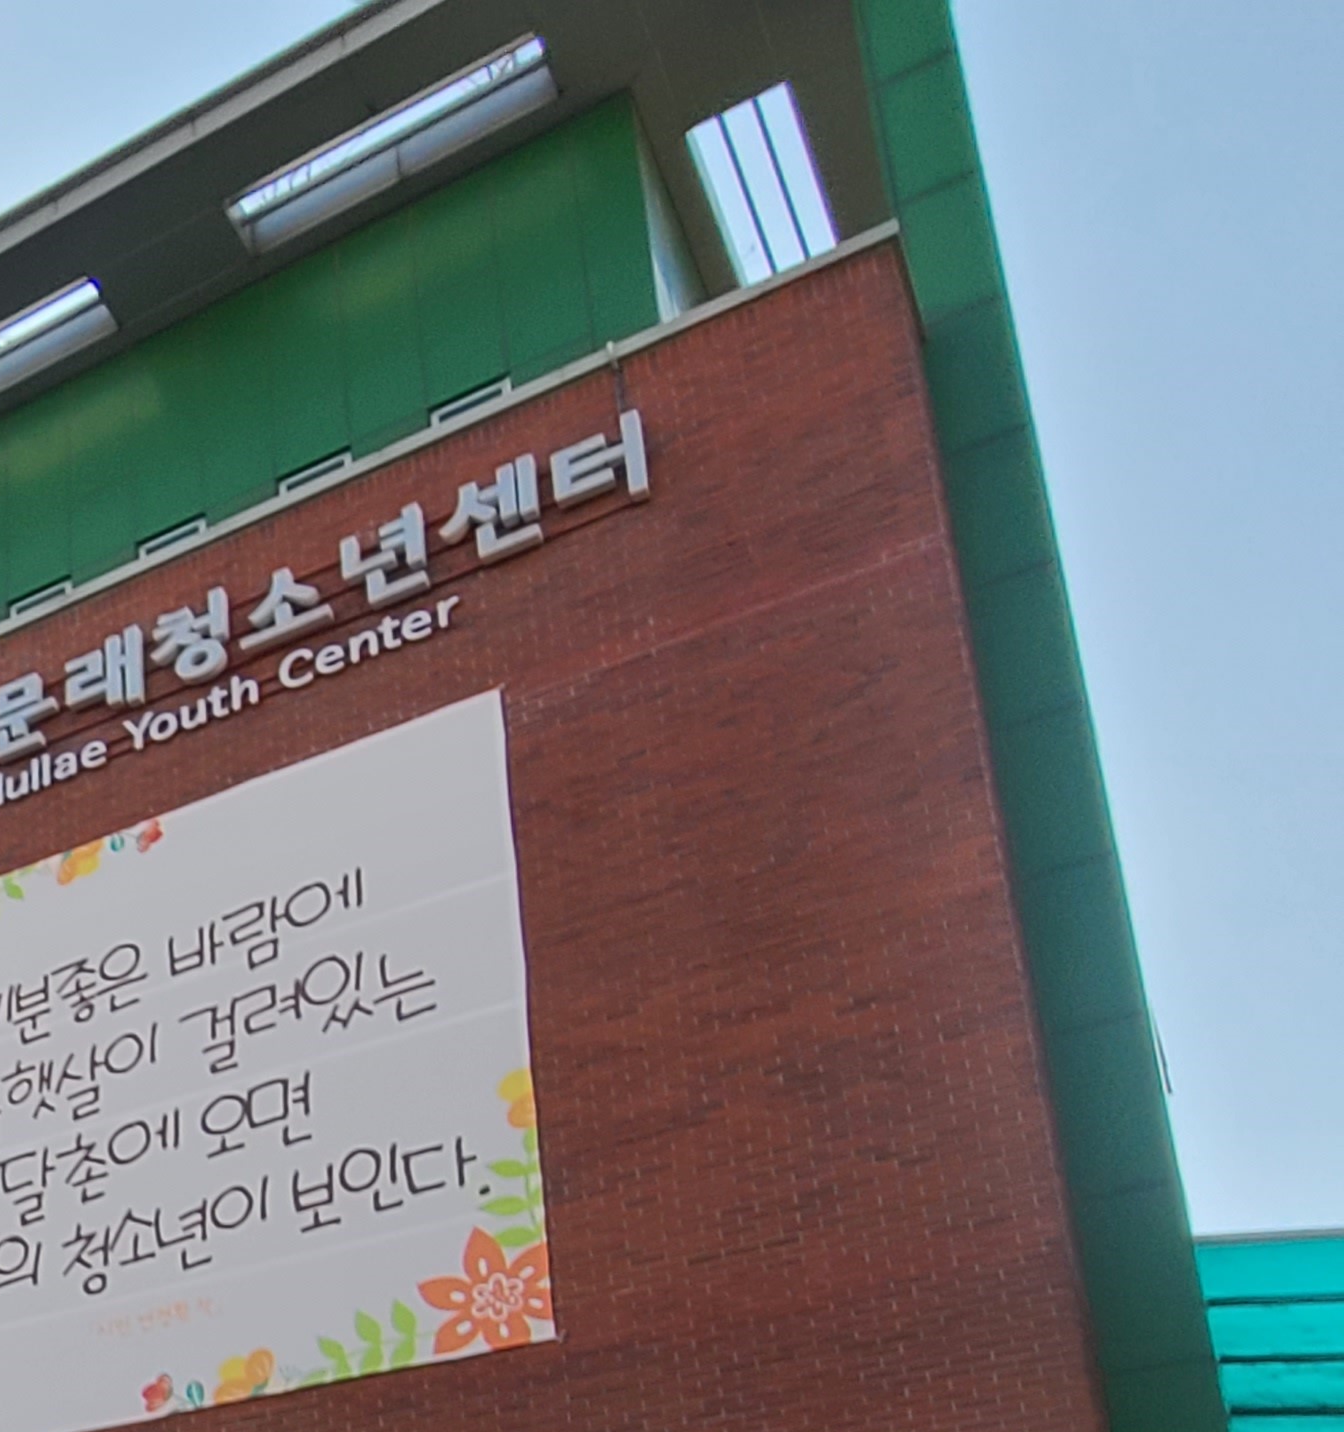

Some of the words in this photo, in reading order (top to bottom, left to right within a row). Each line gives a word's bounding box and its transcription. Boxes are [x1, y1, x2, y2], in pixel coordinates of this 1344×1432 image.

[123, 673, 259, 753] Youth
[277, 595, 460, 690] Center
[168, 867, 364, 970] 바람에
[179, 951, 438, 1074] 걸려있는
[200, 1071, 313, 1159] 오면
[62, 1176, 269, 1297] 청소년이
[292, 1137, 492, 1234] 보인다.
